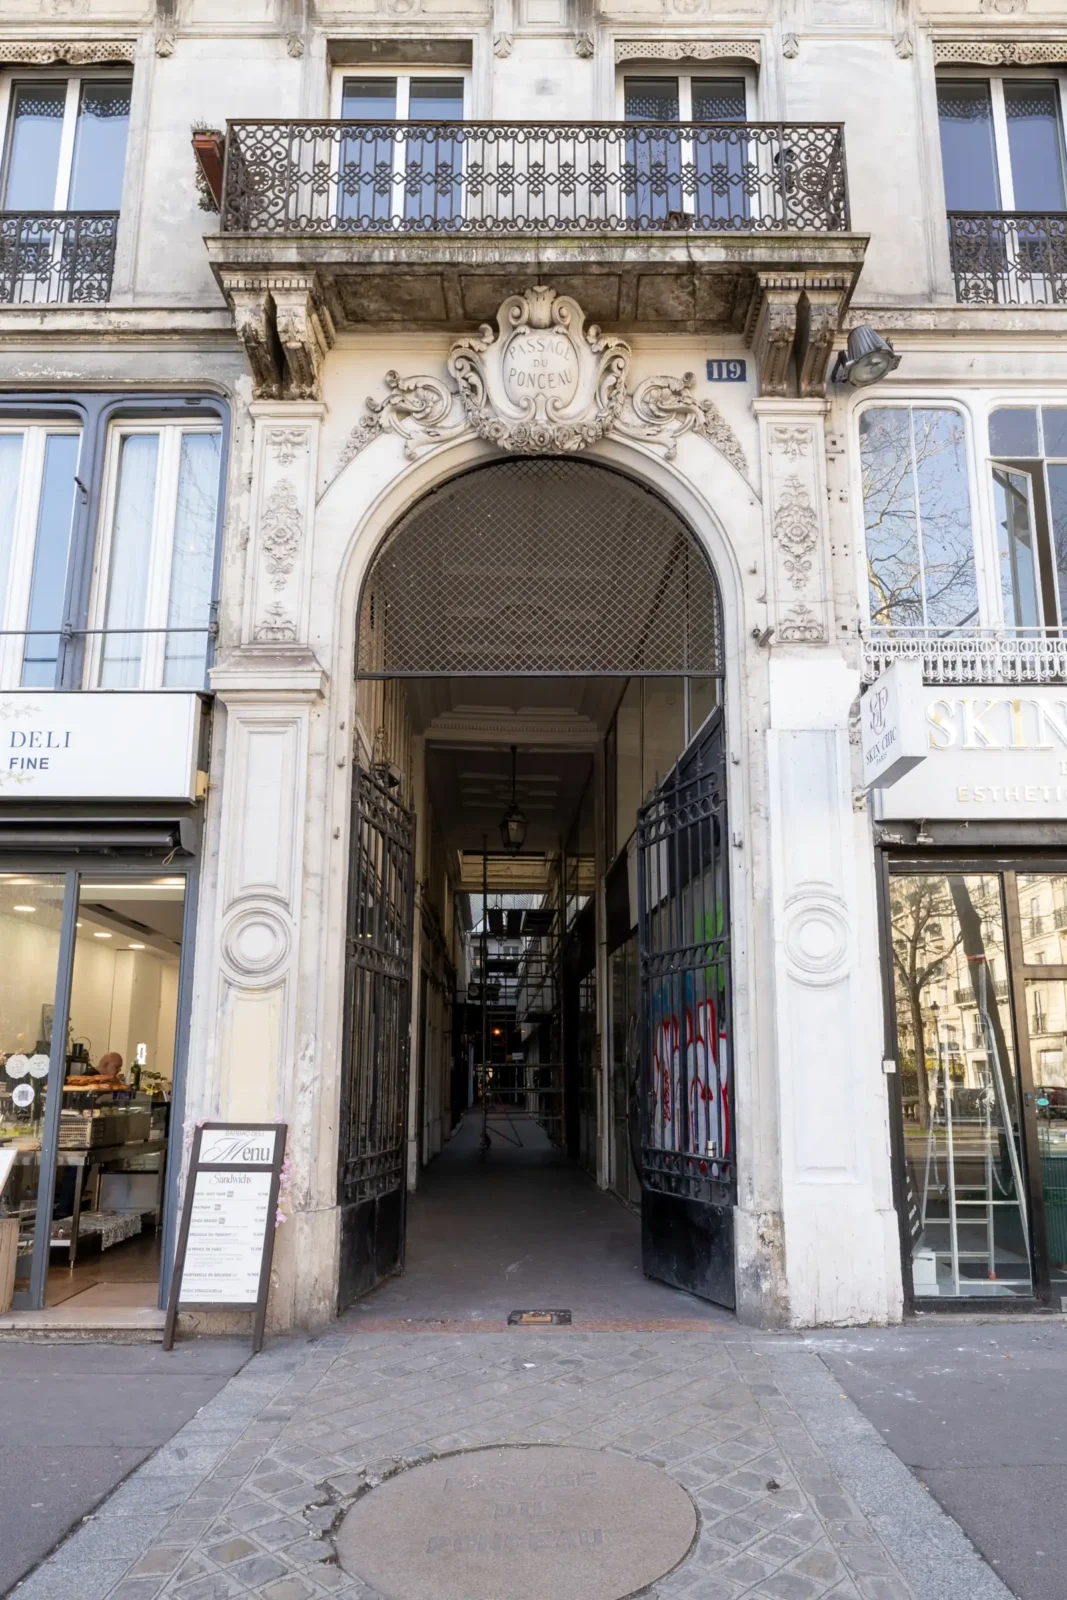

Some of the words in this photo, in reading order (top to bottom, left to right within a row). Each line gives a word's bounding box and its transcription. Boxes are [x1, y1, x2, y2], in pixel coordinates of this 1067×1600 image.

[509, 338, 572, 361] PASSAGE
[533, 359, 549, 368] DU
[711, 361, 742, 379] 119
[508, 367, 573, 390] PONCEAU
[925, 698, 1067, 751] SKIN
[9, 730, 72, 748] DELI
[9, 757, 50, 770] FINE
[957, 785, 1067, 803] ESTHETI
[202, 1137, 270, 1163] Menu
[208, 1174, 252, 1185] Sandwichs
